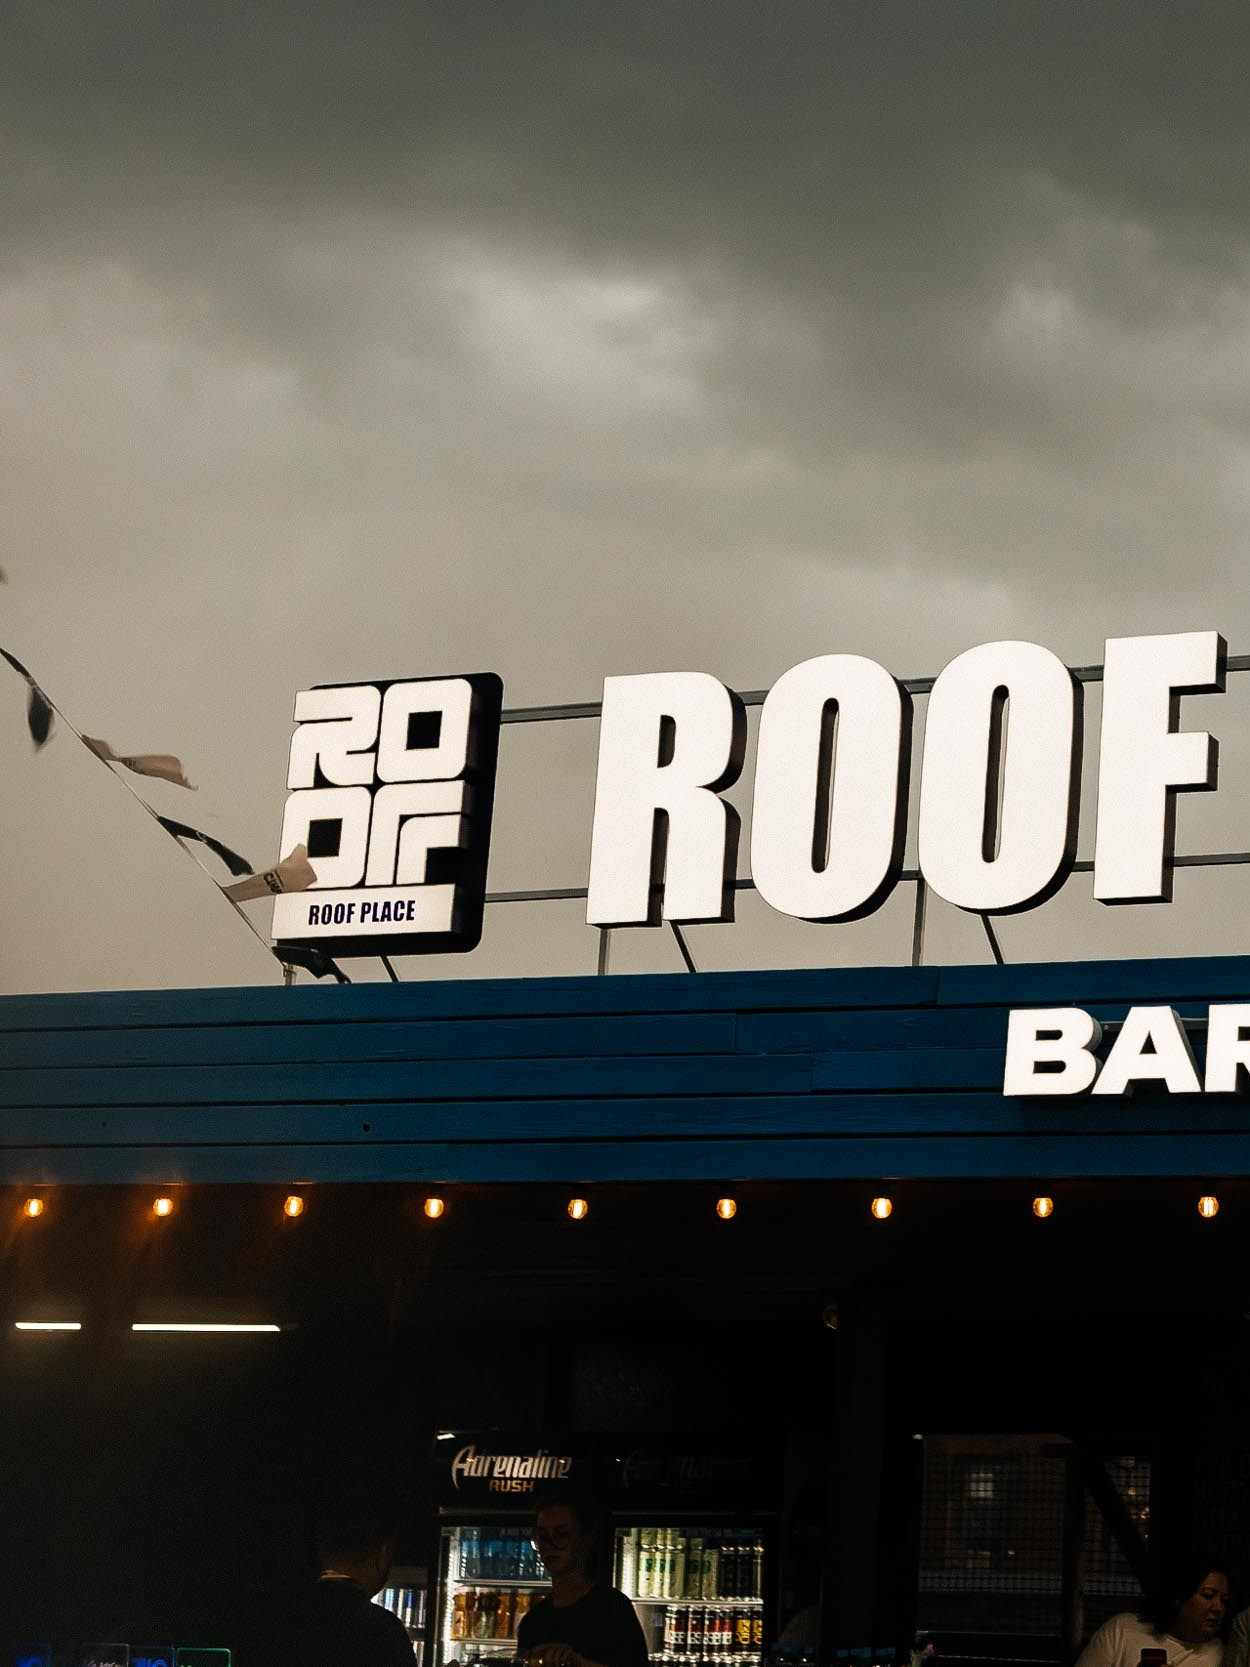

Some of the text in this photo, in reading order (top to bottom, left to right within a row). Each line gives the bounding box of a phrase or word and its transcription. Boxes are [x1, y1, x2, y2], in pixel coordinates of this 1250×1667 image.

[586, 631, 1225, 927] ROOF
[308, 900, 416, 926] ROOF PLACE
[451, 1445, 572, 1489] Adrenaline
[489, 1479, 534, 1493] RUSH
